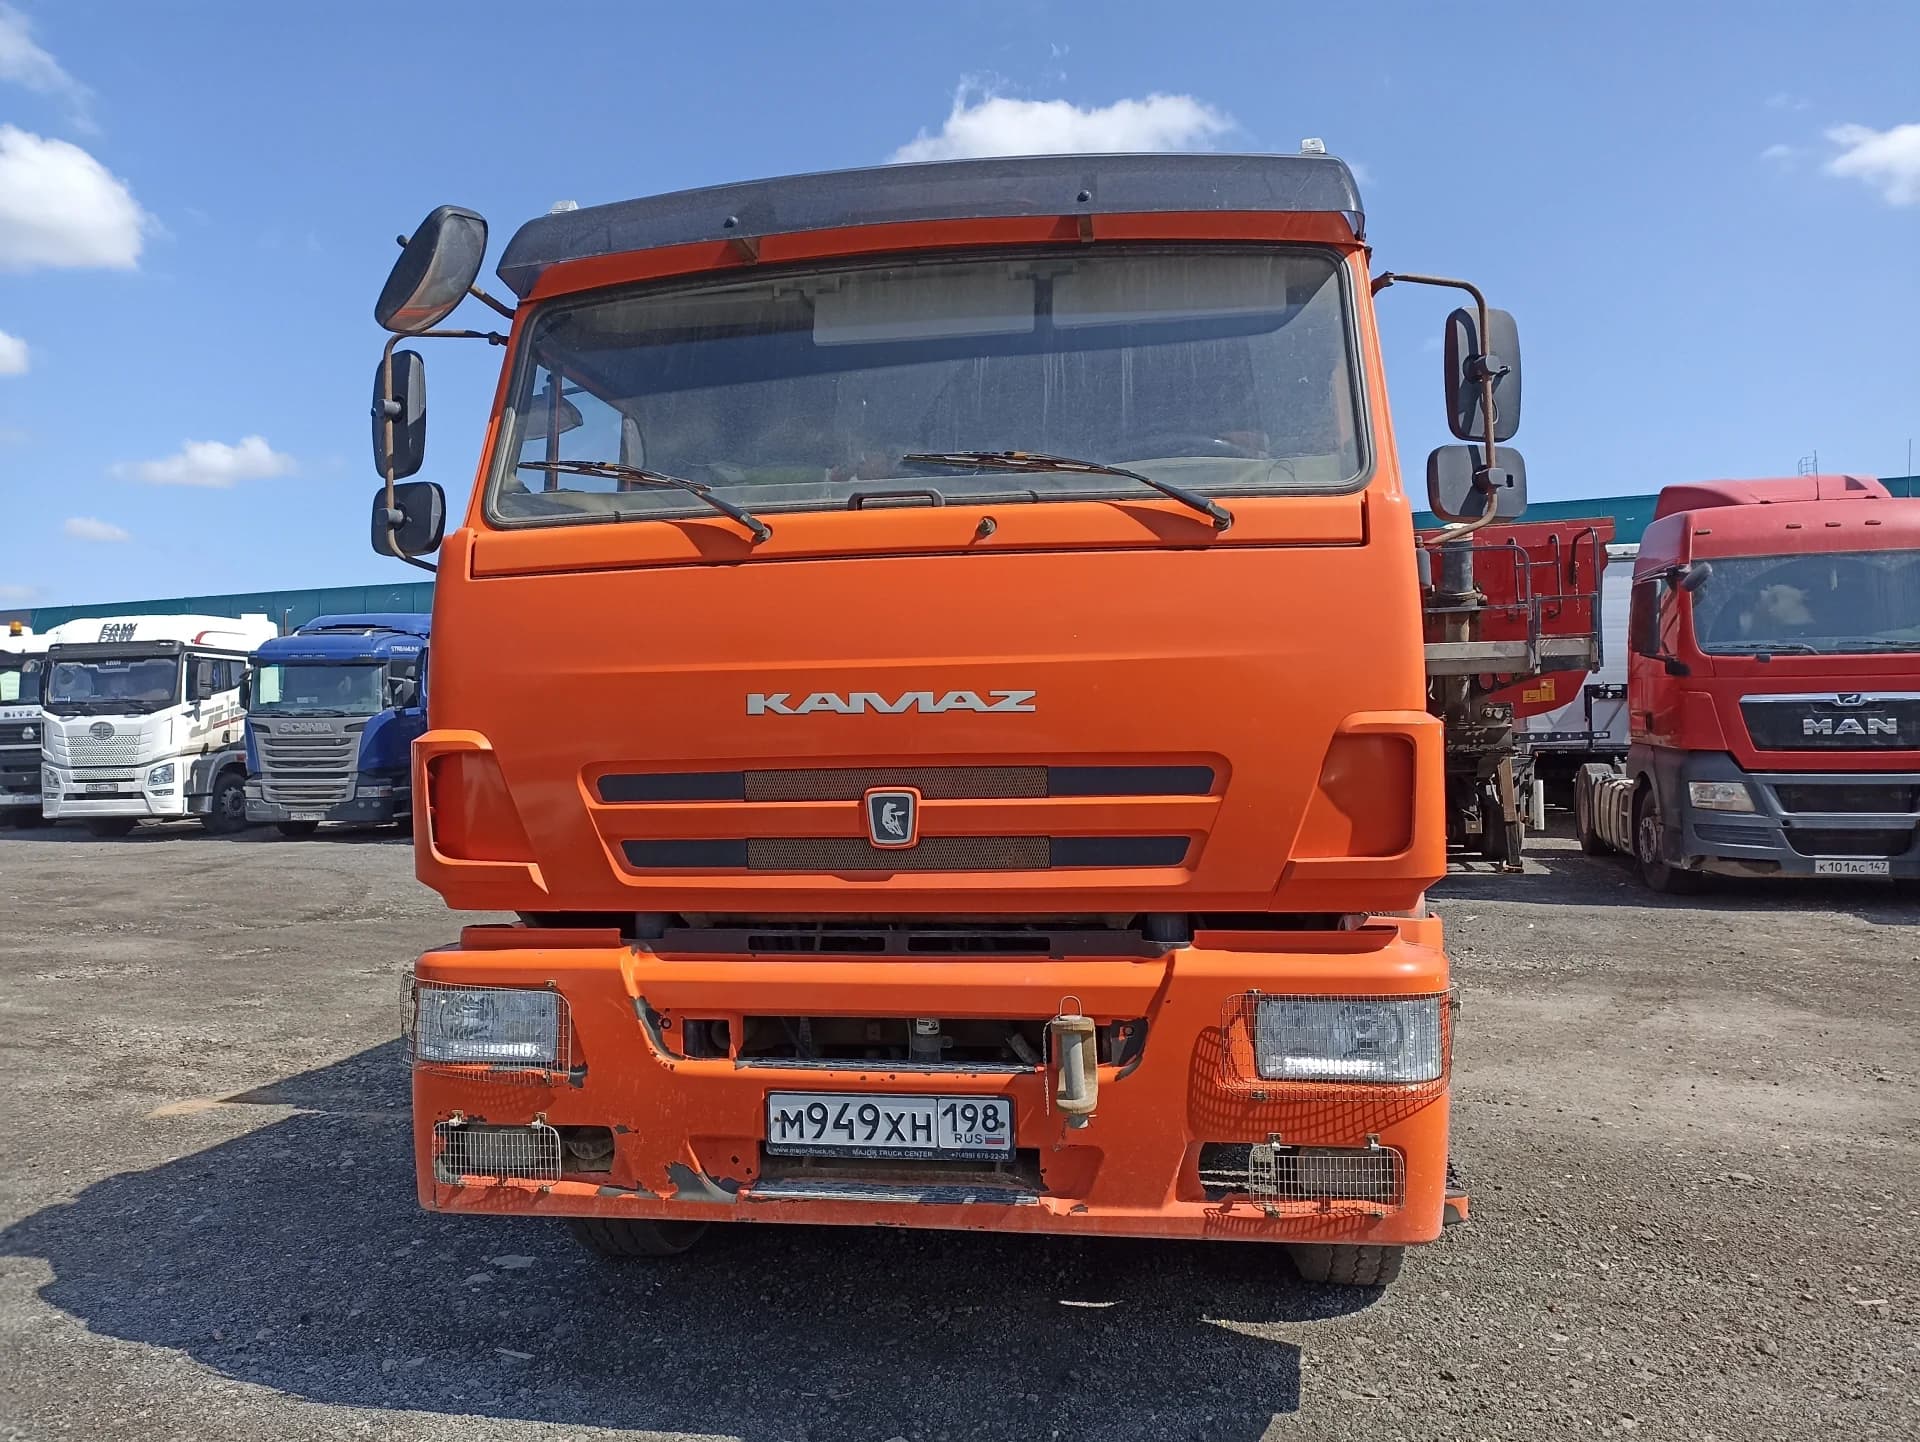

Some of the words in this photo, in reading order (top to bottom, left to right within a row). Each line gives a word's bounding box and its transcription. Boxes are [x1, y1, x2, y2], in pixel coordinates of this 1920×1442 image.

[746, 690, 1037, 715] KAMAZ
[279, 722, 332, 733] SCANIA
[1803, 718, 1897, 735] MAN
[942, 1103, 1000, 1132] 198
[954, 1133, 983, 1144] RUS
[852, 1148, 878, 1157] MAJOR
[879, 1149, 902, 1157] TRUCK
[903, 1150, 933, 1158] CENTER
